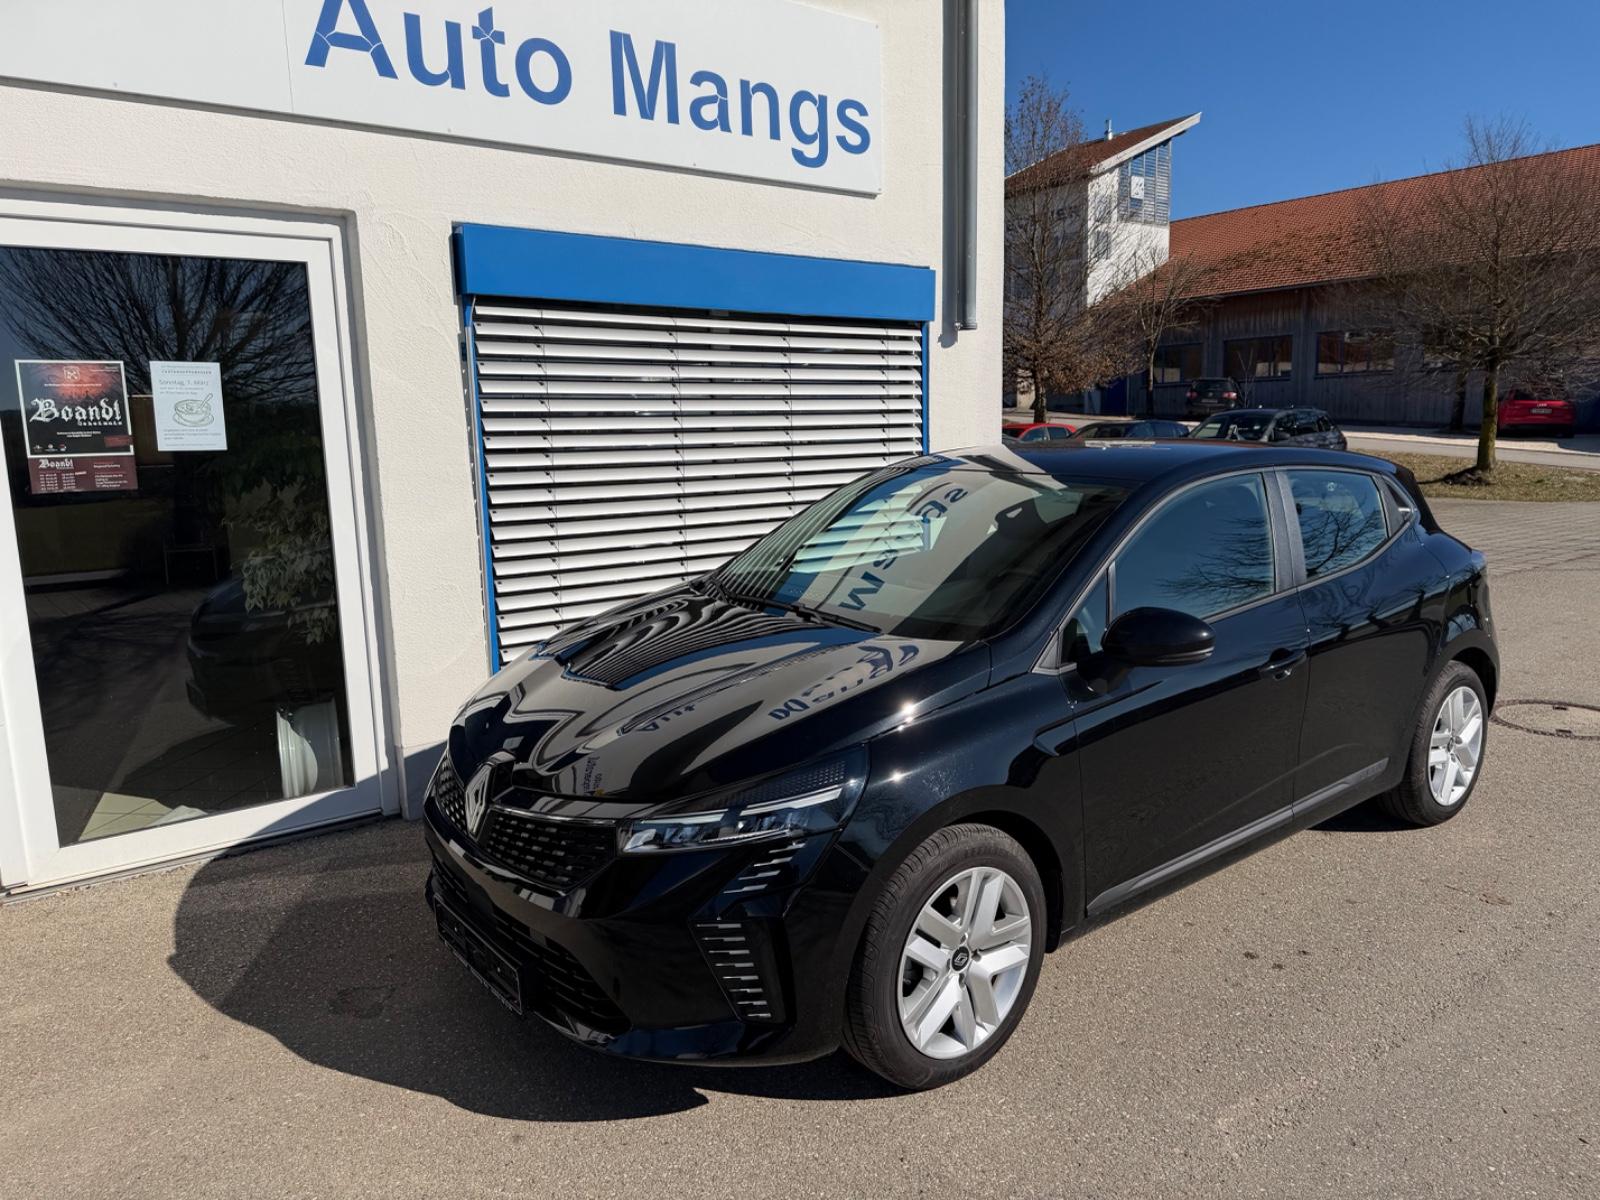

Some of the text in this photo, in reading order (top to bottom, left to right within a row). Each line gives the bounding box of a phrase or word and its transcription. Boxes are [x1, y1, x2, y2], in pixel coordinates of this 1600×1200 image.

[304, 0, 871, 168] Auto Mangs
[29, 397, 122, 423] Boandl
